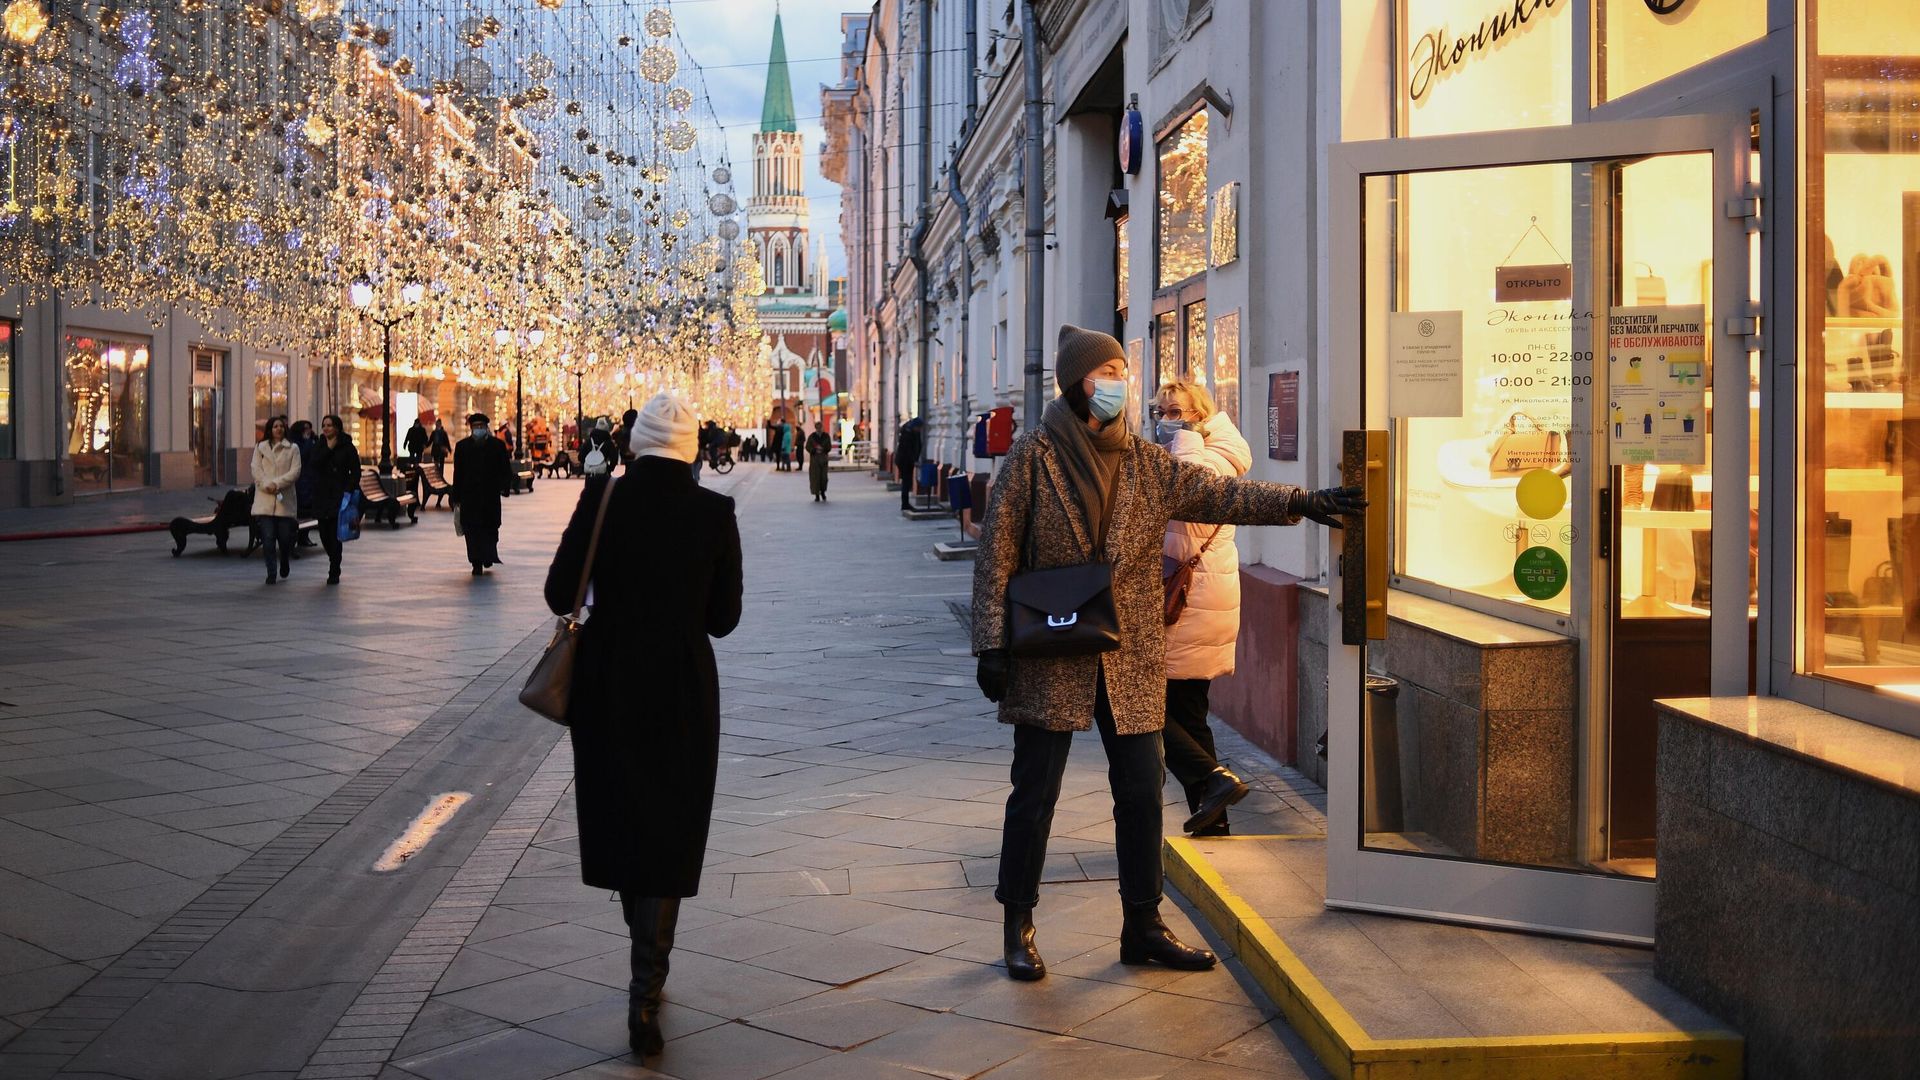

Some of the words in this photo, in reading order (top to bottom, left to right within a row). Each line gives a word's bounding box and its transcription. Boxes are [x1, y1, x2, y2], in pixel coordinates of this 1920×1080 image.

[1505, 278, 1562, 289] ОТКРЫТО
[1487, 308, 1604, 327] Эконика
[1610, 315, 1658, 325] ПОСЕТИТЕЛИ
[1610, 325, 1625, 335] БЕЗ
[1626, 325, 1652, 334] МАСОК
[1653, 324, 1659, 333] И
[1661, 323, 1700, 333] ПЕРЧАТОК
[1610, 337, 1622, 349] НЕ
[1623, 335, 1705, 348] ОБСЛУЖИВАЮТСЯ
[1491, 353, 1532, 363] 10:00
[1549, 352, 1594, 362] 22:00
[1494, 377, 1534, 387] 10:00
[1551, 376, 1592, 386] 21:00
